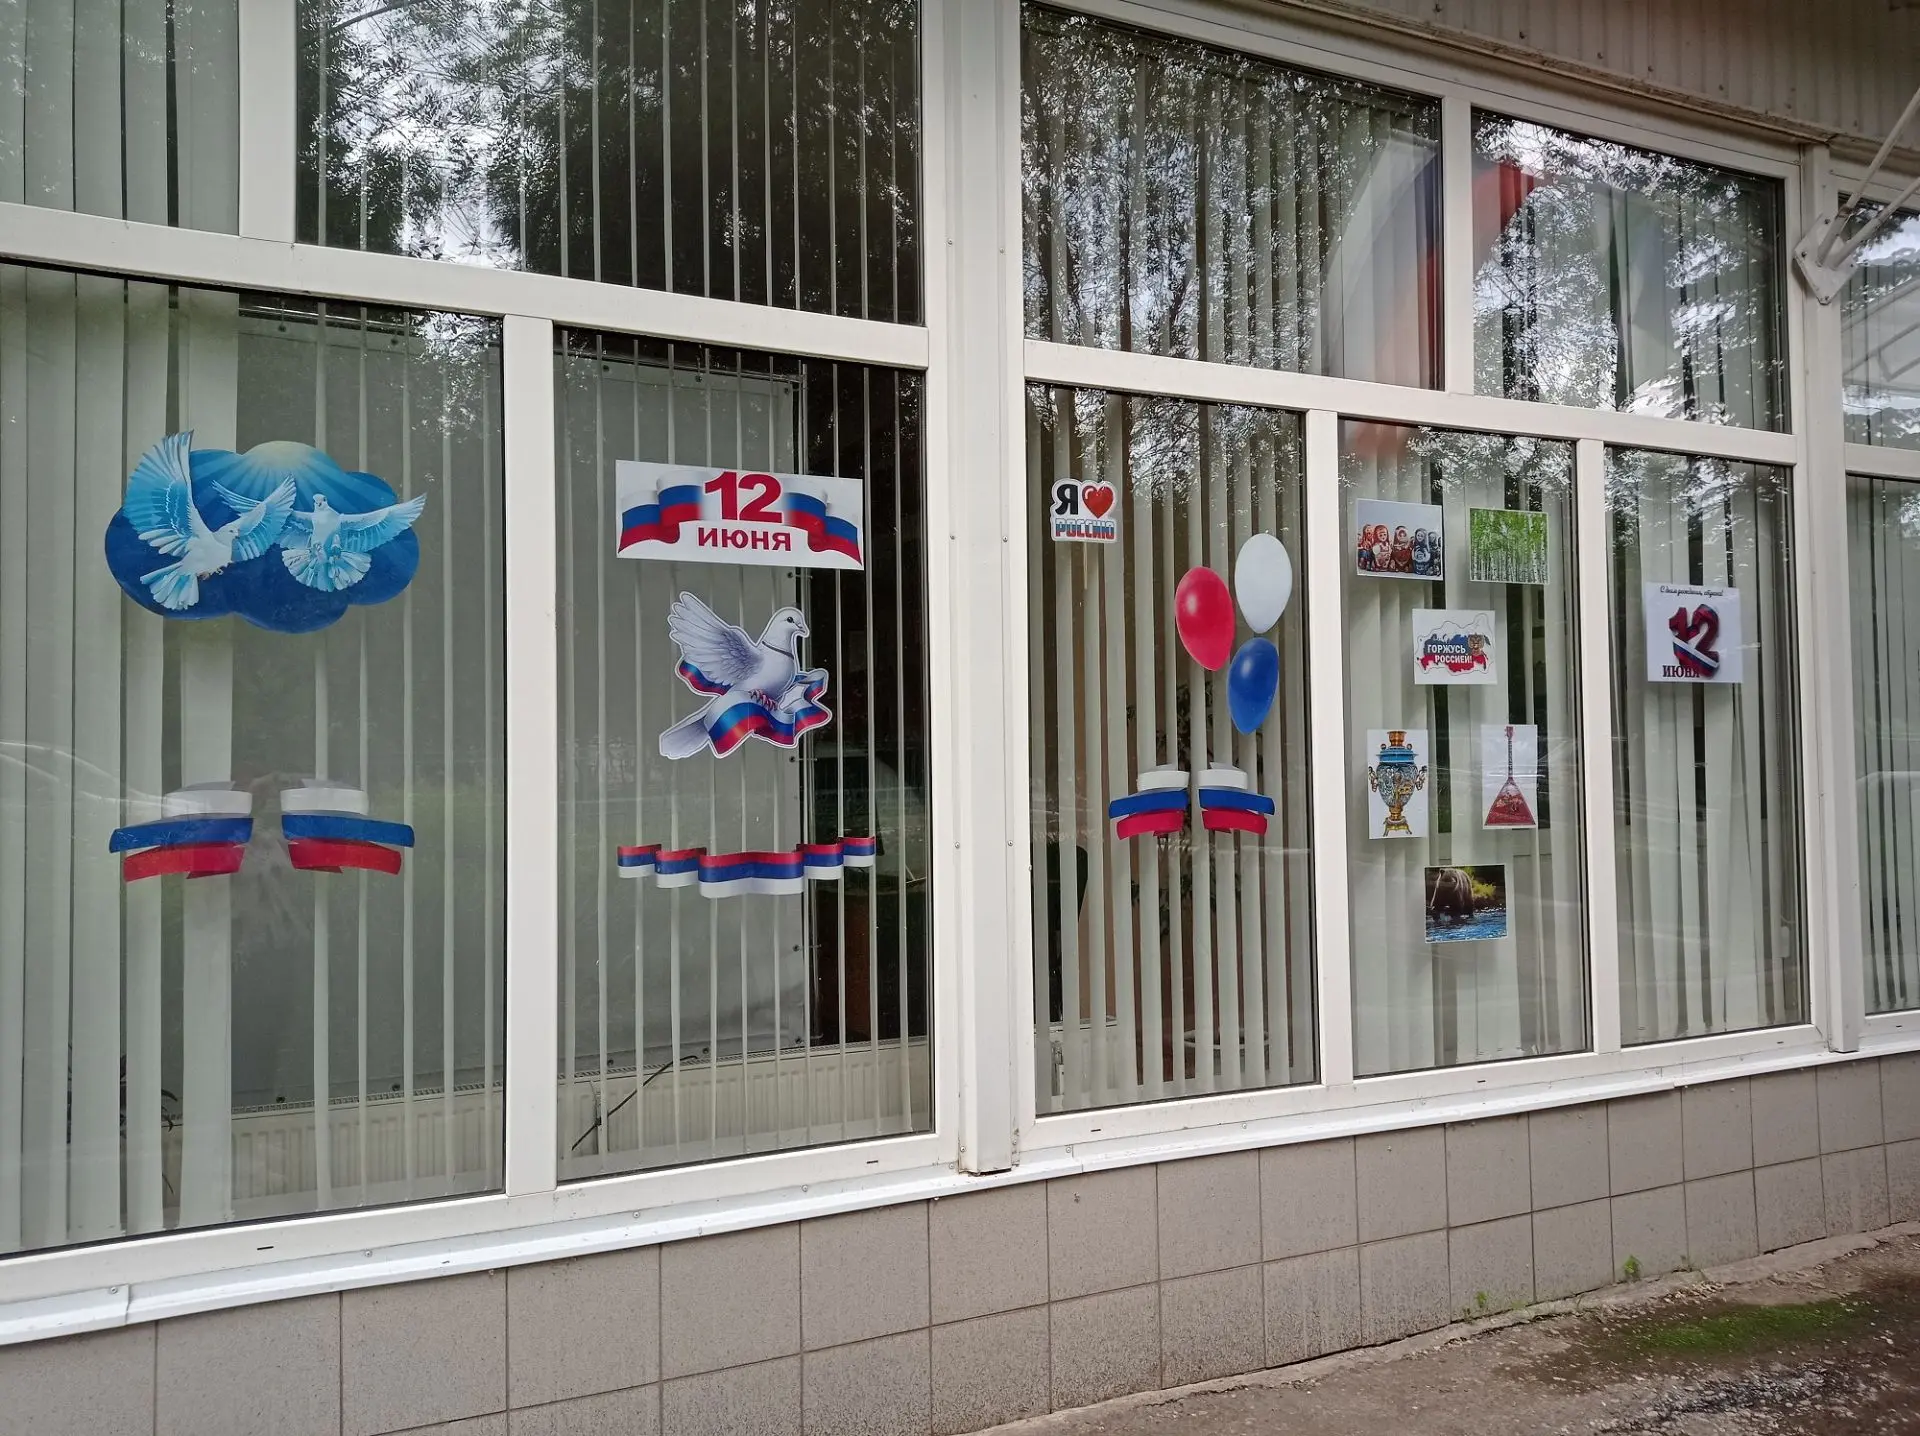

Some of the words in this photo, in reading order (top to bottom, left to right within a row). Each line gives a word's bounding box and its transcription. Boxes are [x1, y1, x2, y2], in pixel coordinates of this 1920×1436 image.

[704, 471, 783, 524] 12
[1055, 483, 1079, 515] Я
[698, 527, 792, 552] ИЮНЯ
[1055, 518, 1115, 540] РОССИЮ
[1427, 644, 1467, 654] ГОРЖУСЬ
[1668, 603, 1720, 672] 12
